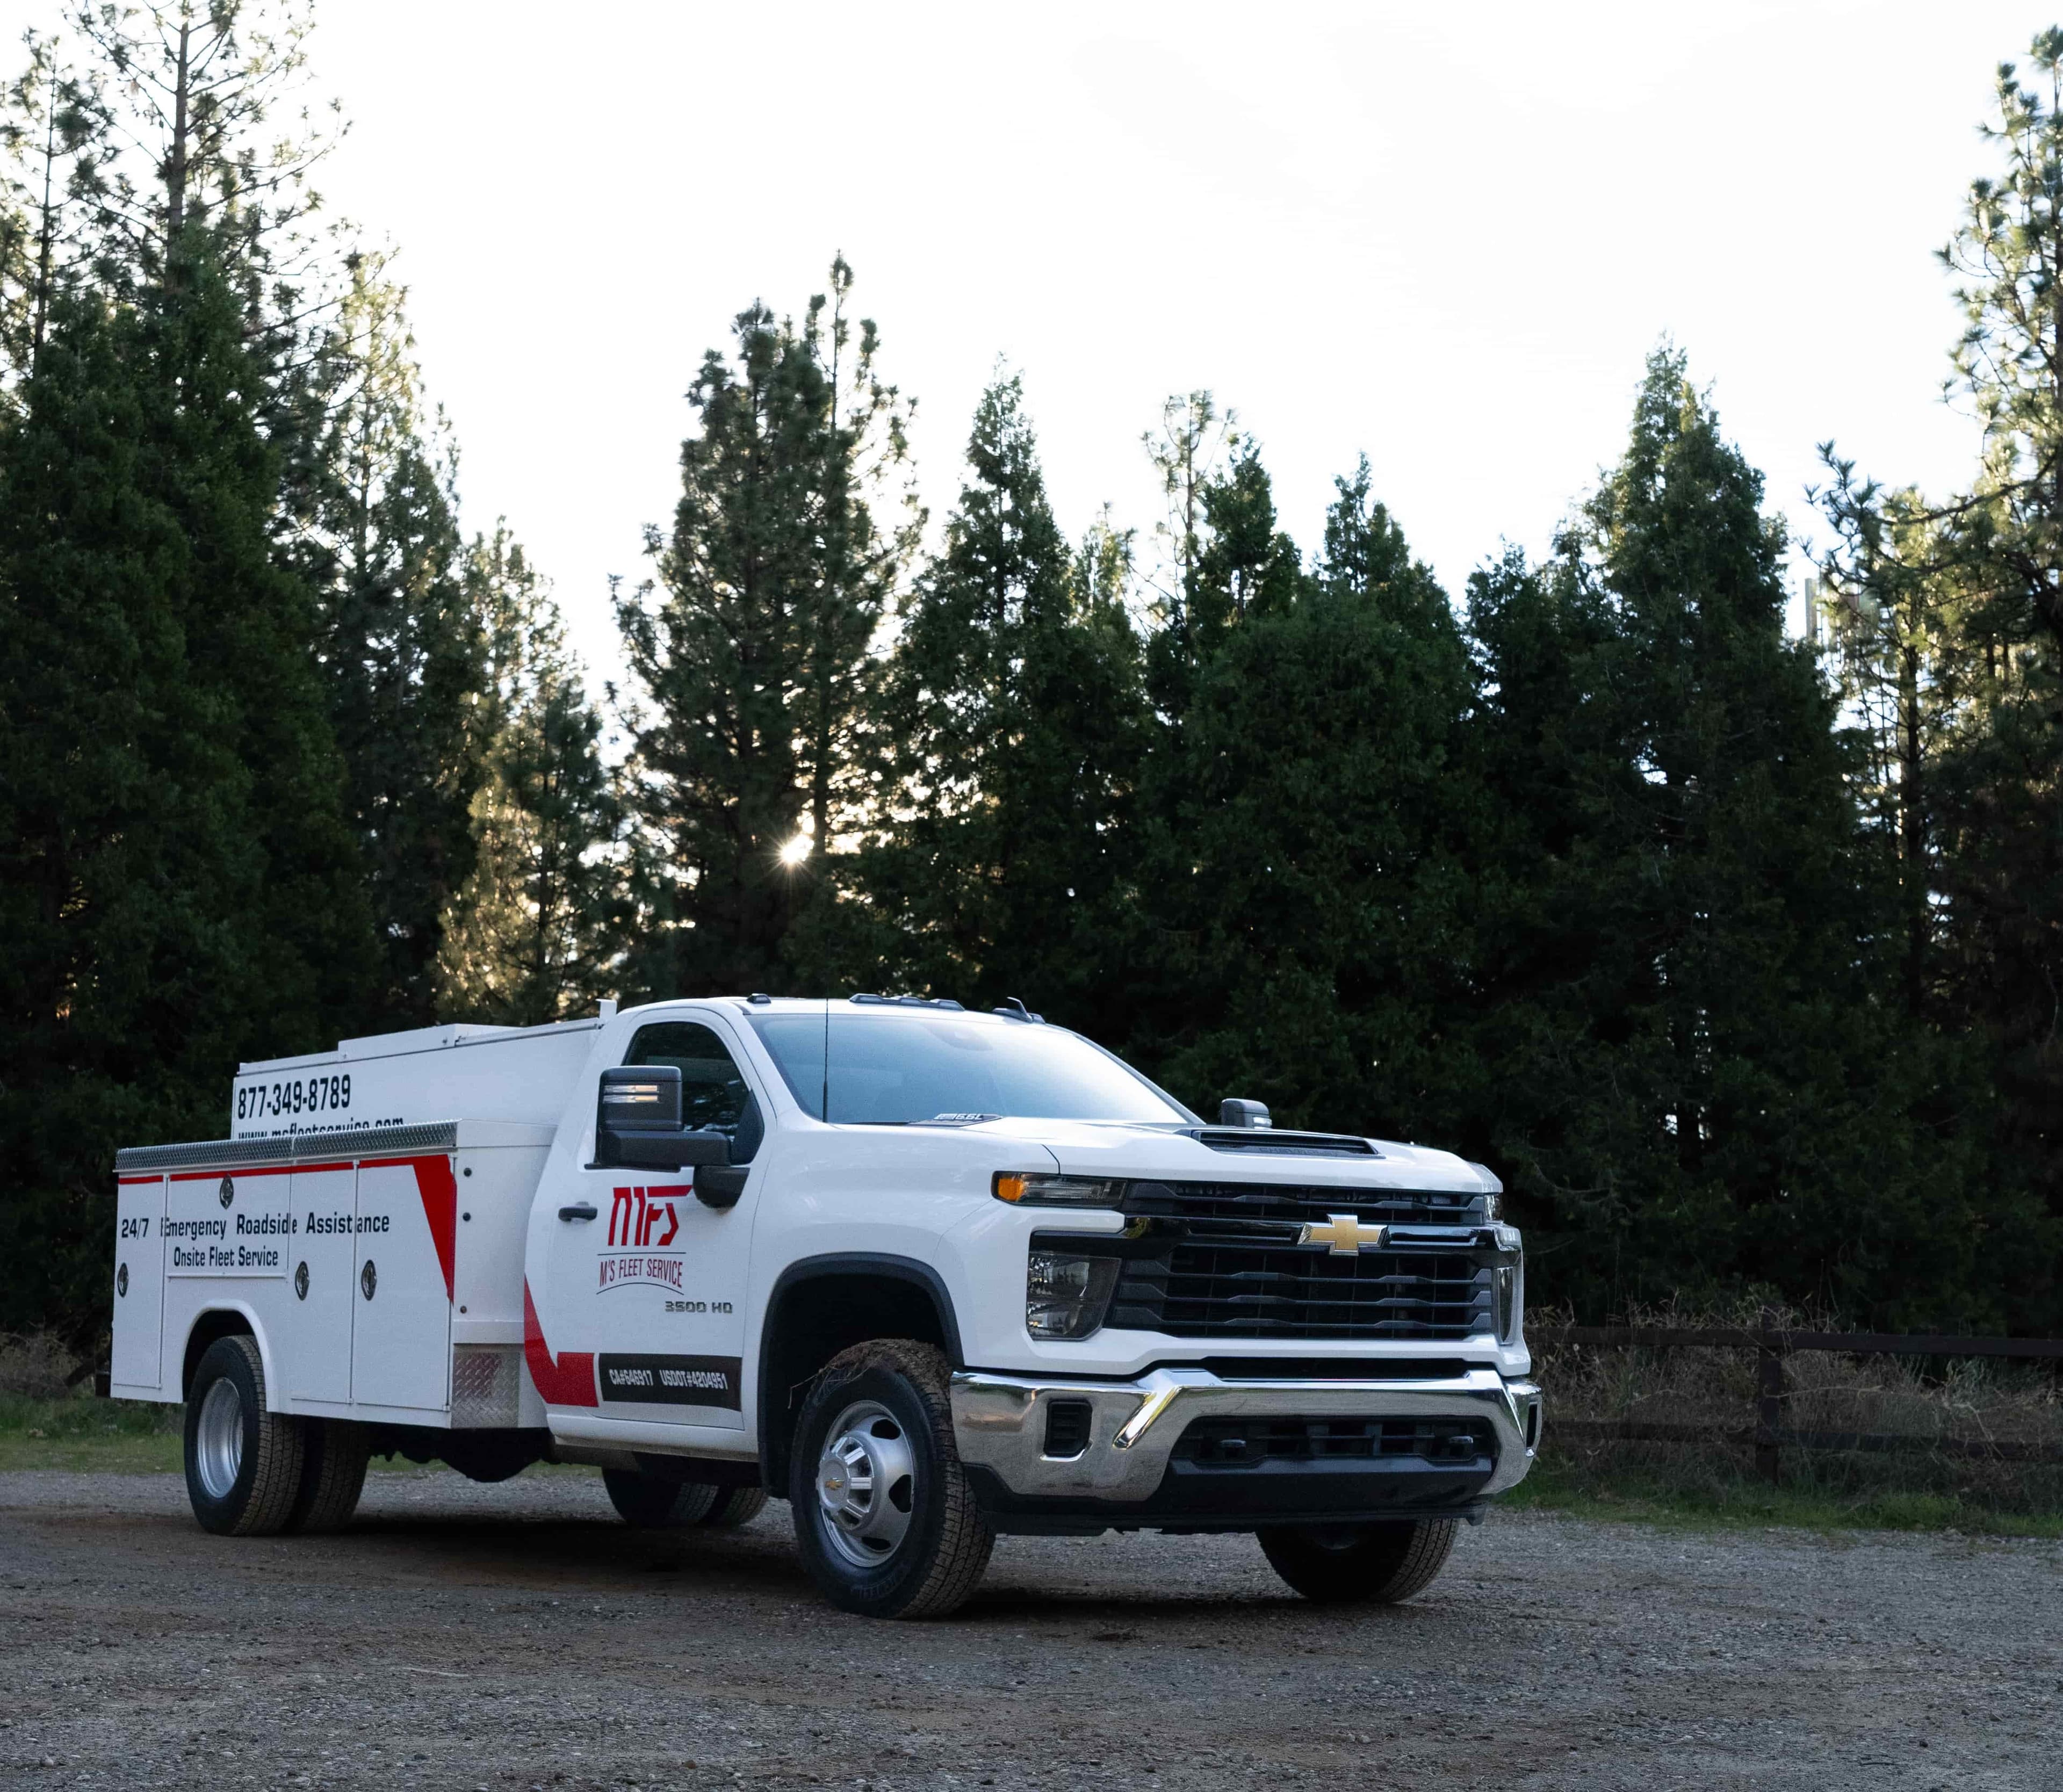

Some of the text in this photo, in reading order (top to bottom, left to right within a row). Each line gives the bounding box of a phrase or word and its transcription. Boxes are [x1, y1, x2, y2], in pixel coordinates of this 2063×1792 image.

[238, 1074, 351, 1119] 877-349-8789
[121, 1211, 390, 1241] 24/7 Emergency Roadside Assistance
[608, 1184, 694, 1246] MFS
[174, 1245, 278, 1267] Onsite Fleet Service
[600, 1259, 683, 1289] M'S FLEET SERVICE
[665, 1301, 733, 1313] 3500 HD
[609, 1369, 728, 1390] CA#646917 USDOT#4204951
